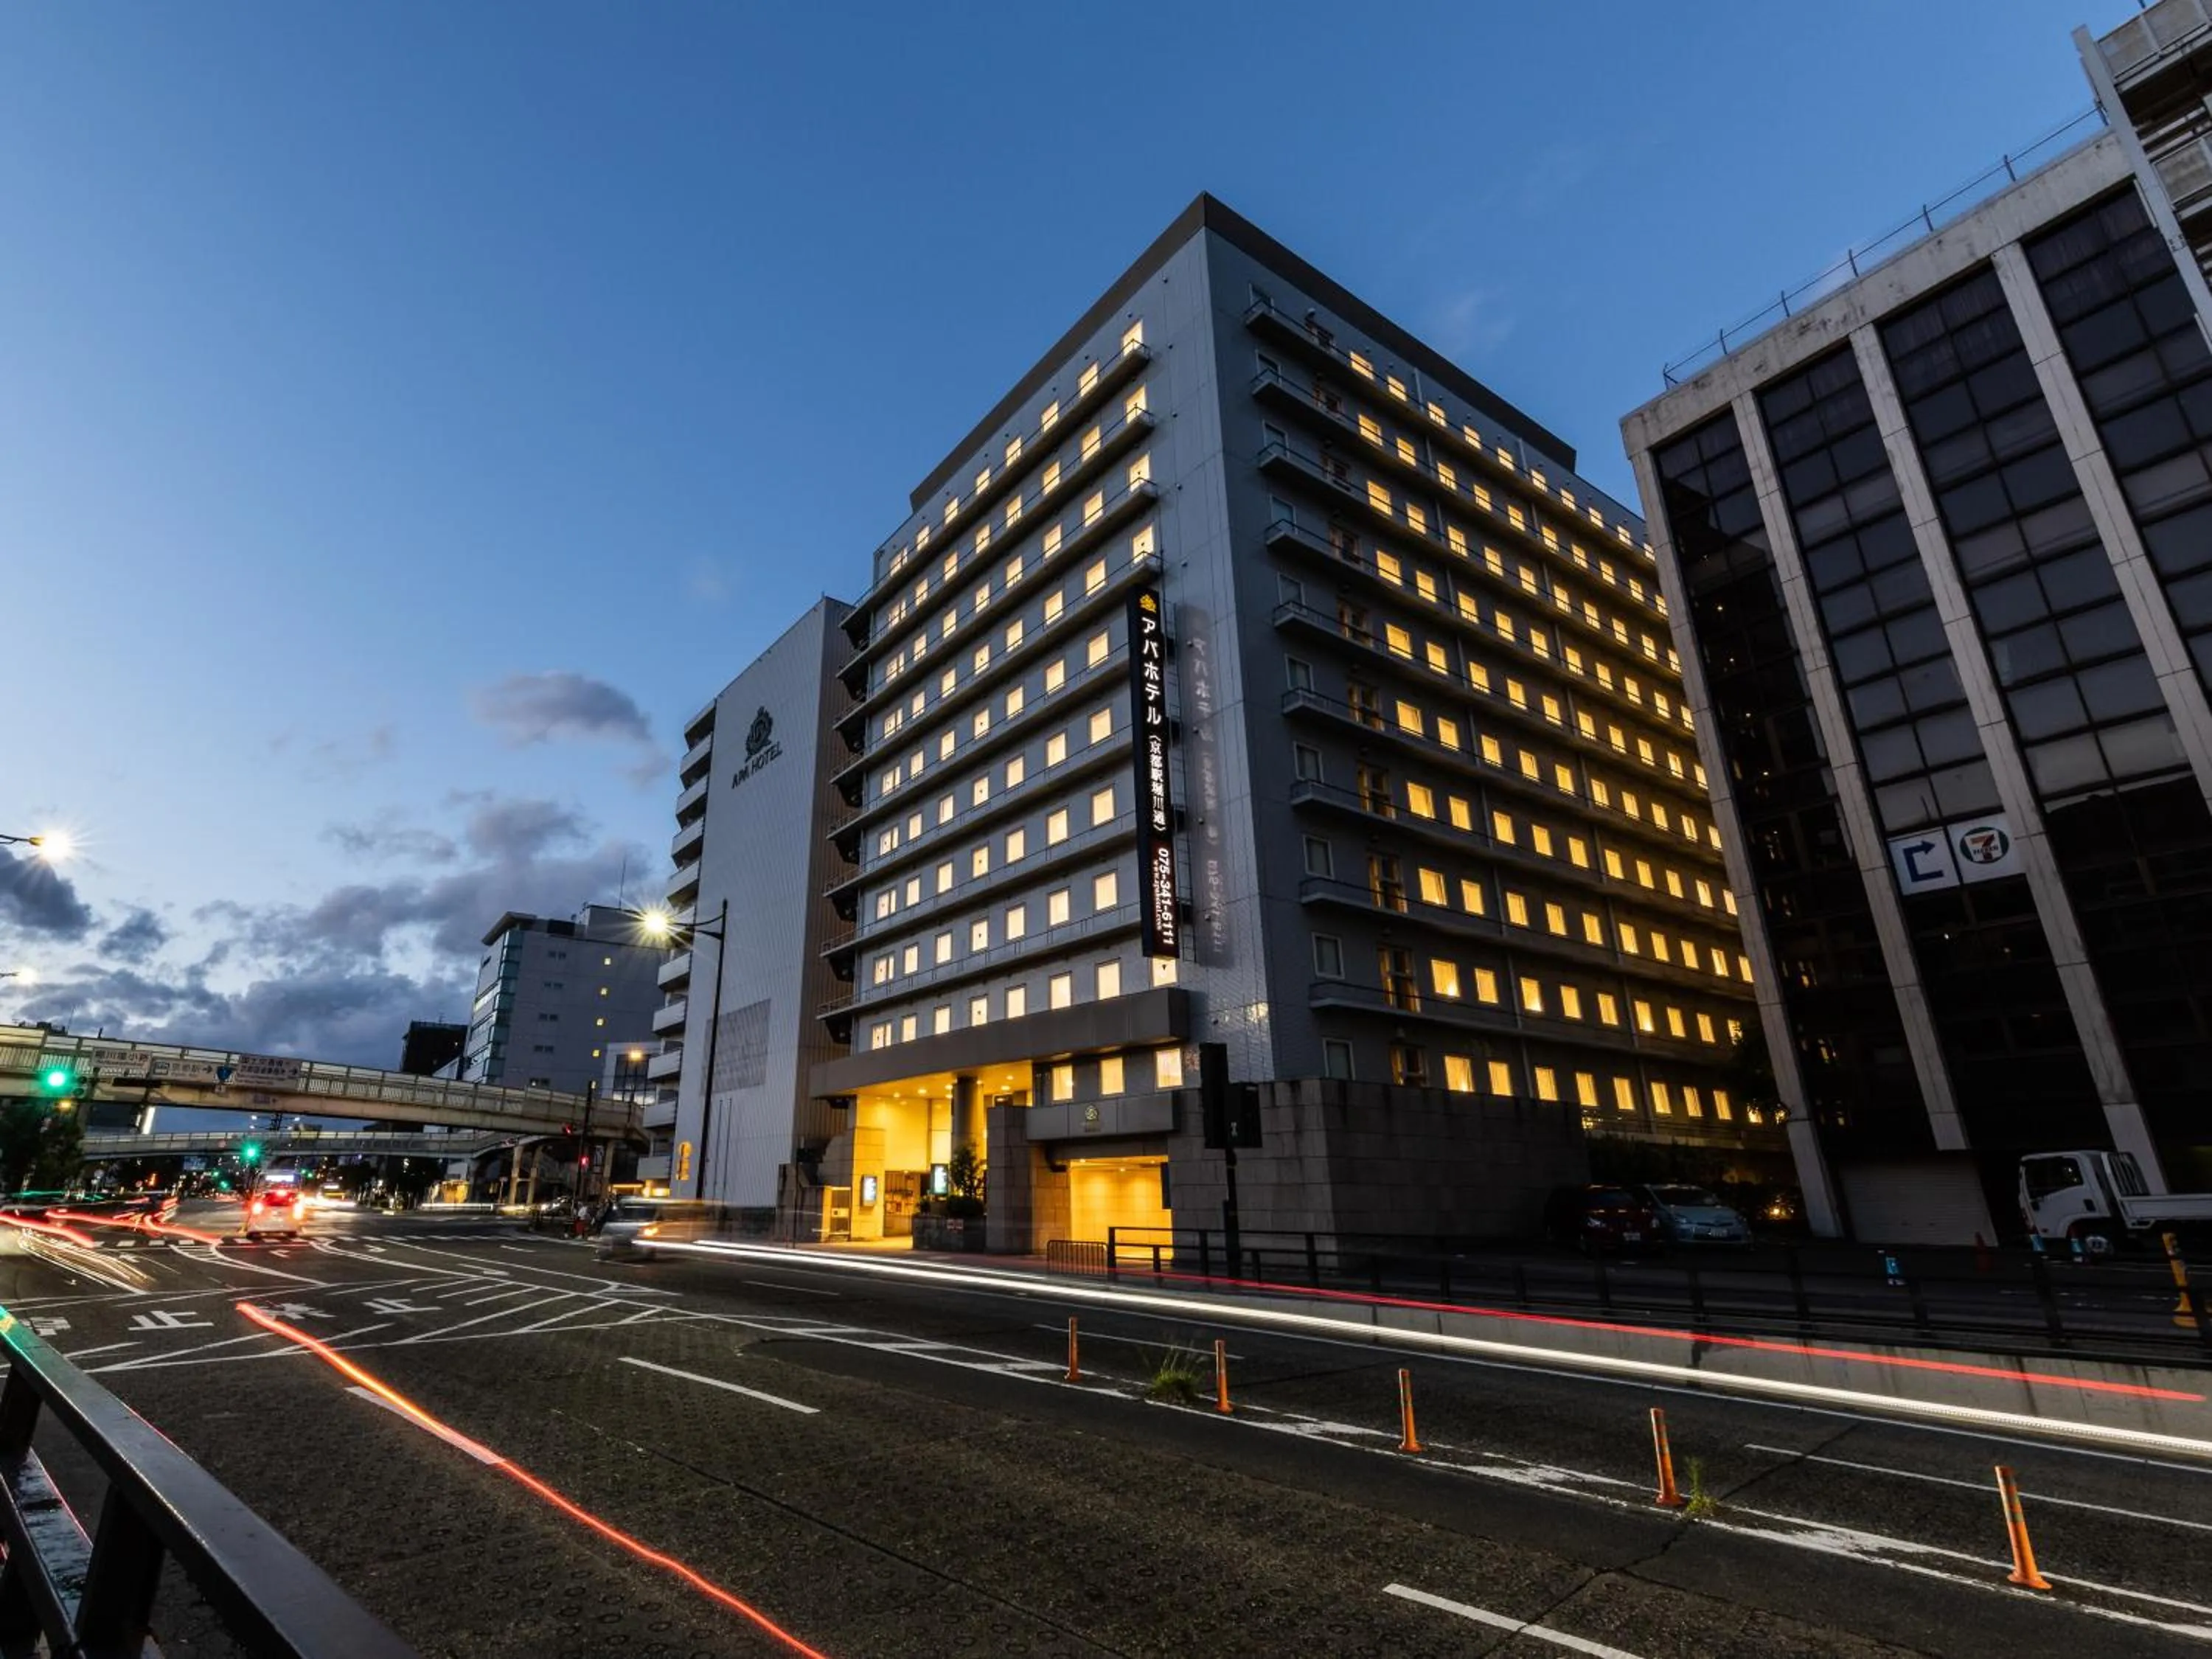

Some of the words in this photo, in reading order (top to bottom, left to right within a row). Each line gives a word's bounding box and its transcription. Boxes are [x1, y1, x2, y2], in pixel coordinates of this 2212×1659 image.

[1141, 616, 1162, 725] アパホテル
[751, 740, 783, 775] HOTEL
[1158, 847, 1175, 945] 075-341-6111
